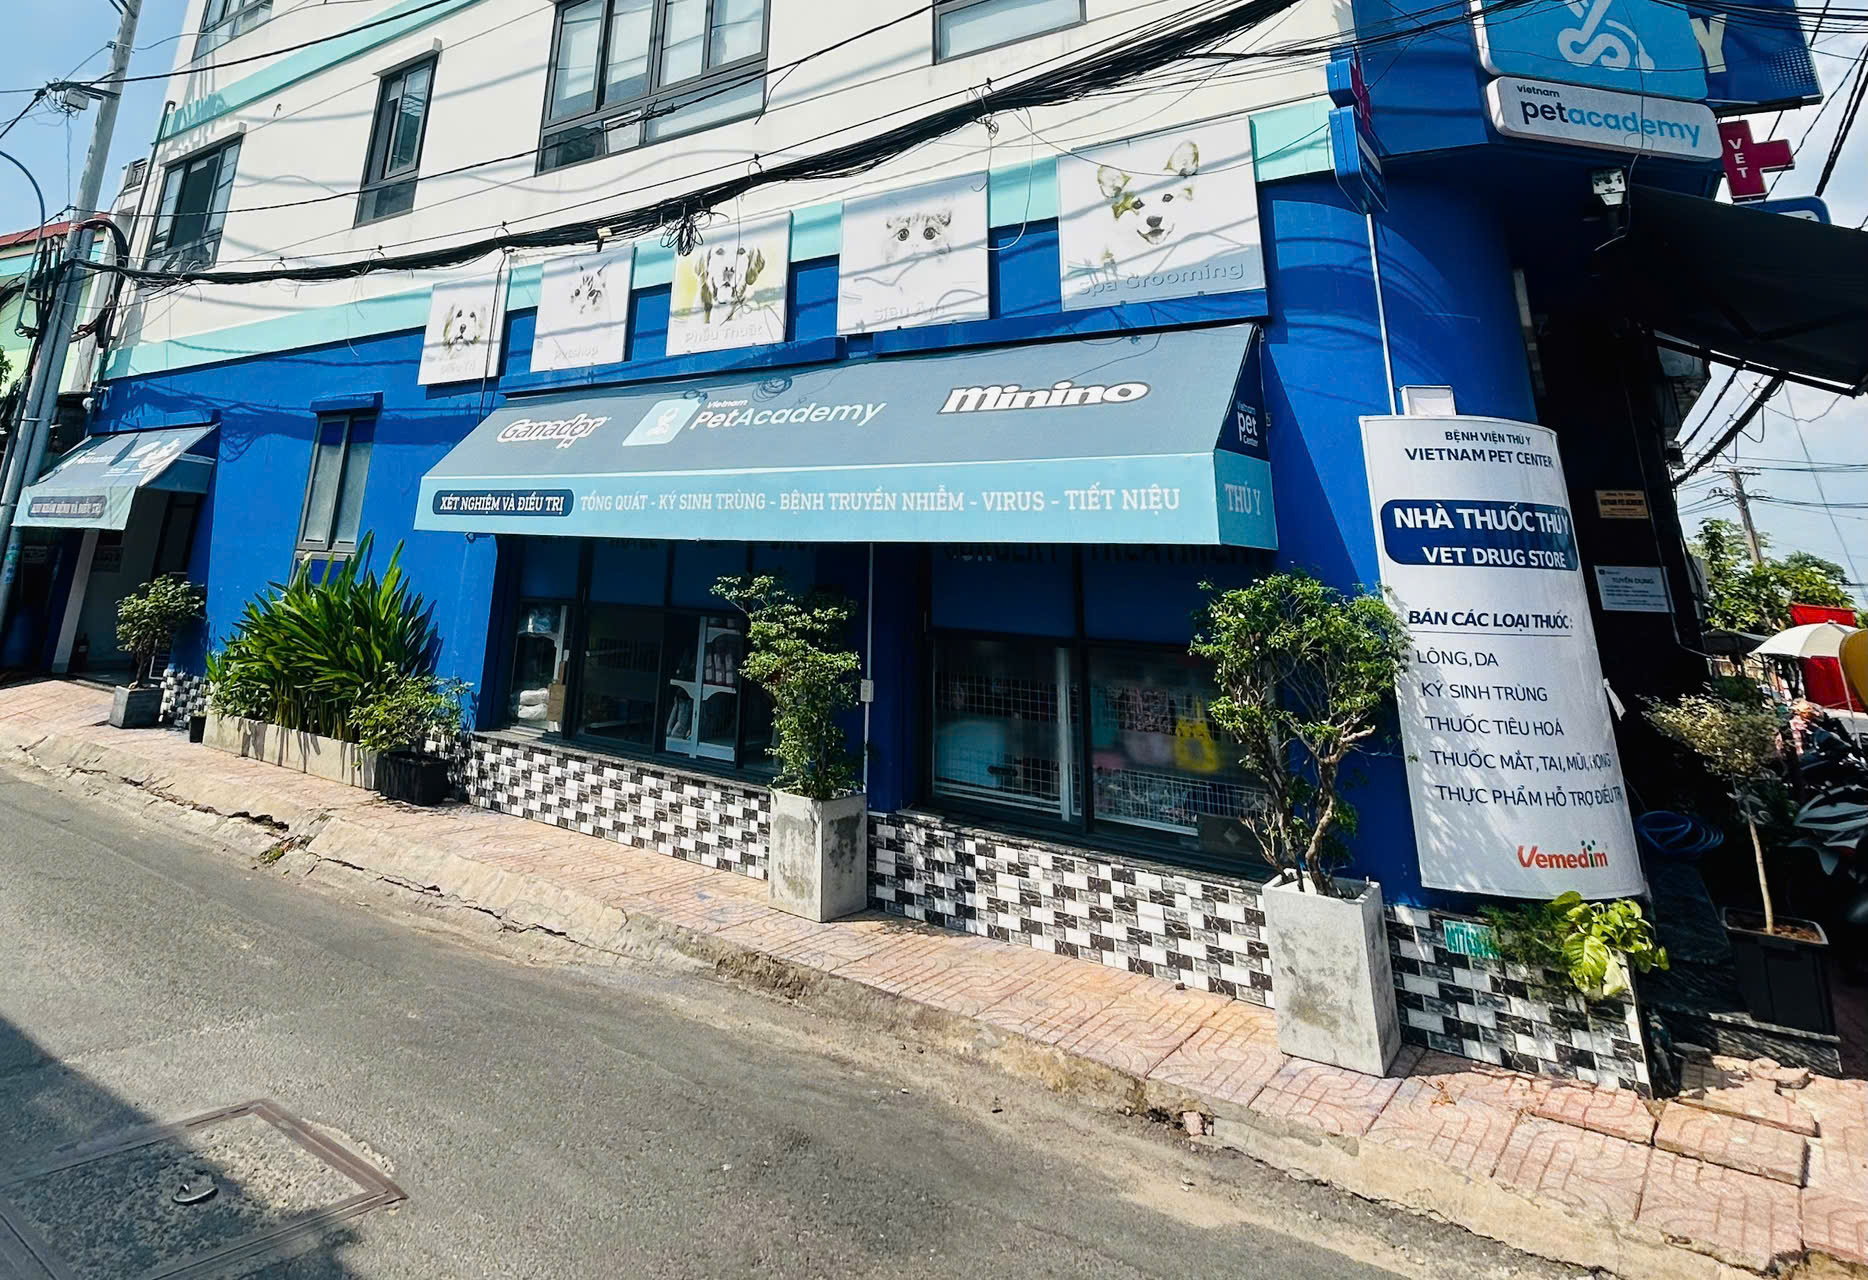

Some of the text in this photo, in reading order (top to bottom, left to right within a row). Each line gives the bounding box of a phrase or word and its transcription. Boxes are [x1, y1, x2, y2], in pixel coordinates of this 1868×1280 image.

[1516, 84, 1561, 98] vietnam
[1520, 99, 1701, 149] petacademy
[1727, 137, 1749, 179] VET
[1079, 263, 1244, 298] Spa Grooming
[689, 401, 888, 432] PetAcademy
[706, 399, 749, 410] Vietnam
[497, 412, 608, 449] Ganador
[1236, 410, 1258, 442] pet
[1445, 429, 1479, 443] BỆNH
[1480, 431, 1506, 445] VIỆN
[1526, 434, 1532, 446] Y
[1404, 447, 1554, 469] VIETNAM PET CENTER
[439, 491, 460, 511] XÉT
[460, 494, 502, 515] NGHIỆM
[502, 492, 517, 512] VÀ
[545, 496, 565, 516] TRỊ
[615, 489, 649, 513] QUÁT
[658, 488, 677, 511] KÝ
[679, 492, 713, 511] SINH
[716, 487, 766, 511] TRÙNG
[779, 488, 825, 515] BỆNH
[981, 490, 1046, 512] VIRUS
[1064, 481, 1116, 512] TIẾT
[1121, 483, 1181, 516] NIỆU
[1393, 502, 1455, 530] NHÀ
[1455, 502, 1536, 532] THUỐC
[1561, 514, 1570, 536] Y
[1421, 546, 1568, 569] VET DRUG STORE
[1407, 607, 1448, 626] BÁN
[1451, 609, 1489, 627] CÁC
[1492, 612, 1530, 632] LOẠI
[1415, 646, 1499, 668] LÔNG, DA
[1450, 683, 1491, 700] SINH
[1493, 682, 1548, 702] TRÙNG
[1424, 712, 1491, 734] THUỐC
[1493, 717, 1530, 736] TIÊU
[1430, 747, 1497, 770] THUỐC
[1434, 784, 1489, 804] THỰC
[1492, 784, 1543, 807] PHẨM
[1546, 784, 1567, 807] HỖ
[1517, 840, 1609, 869] Vemedim
